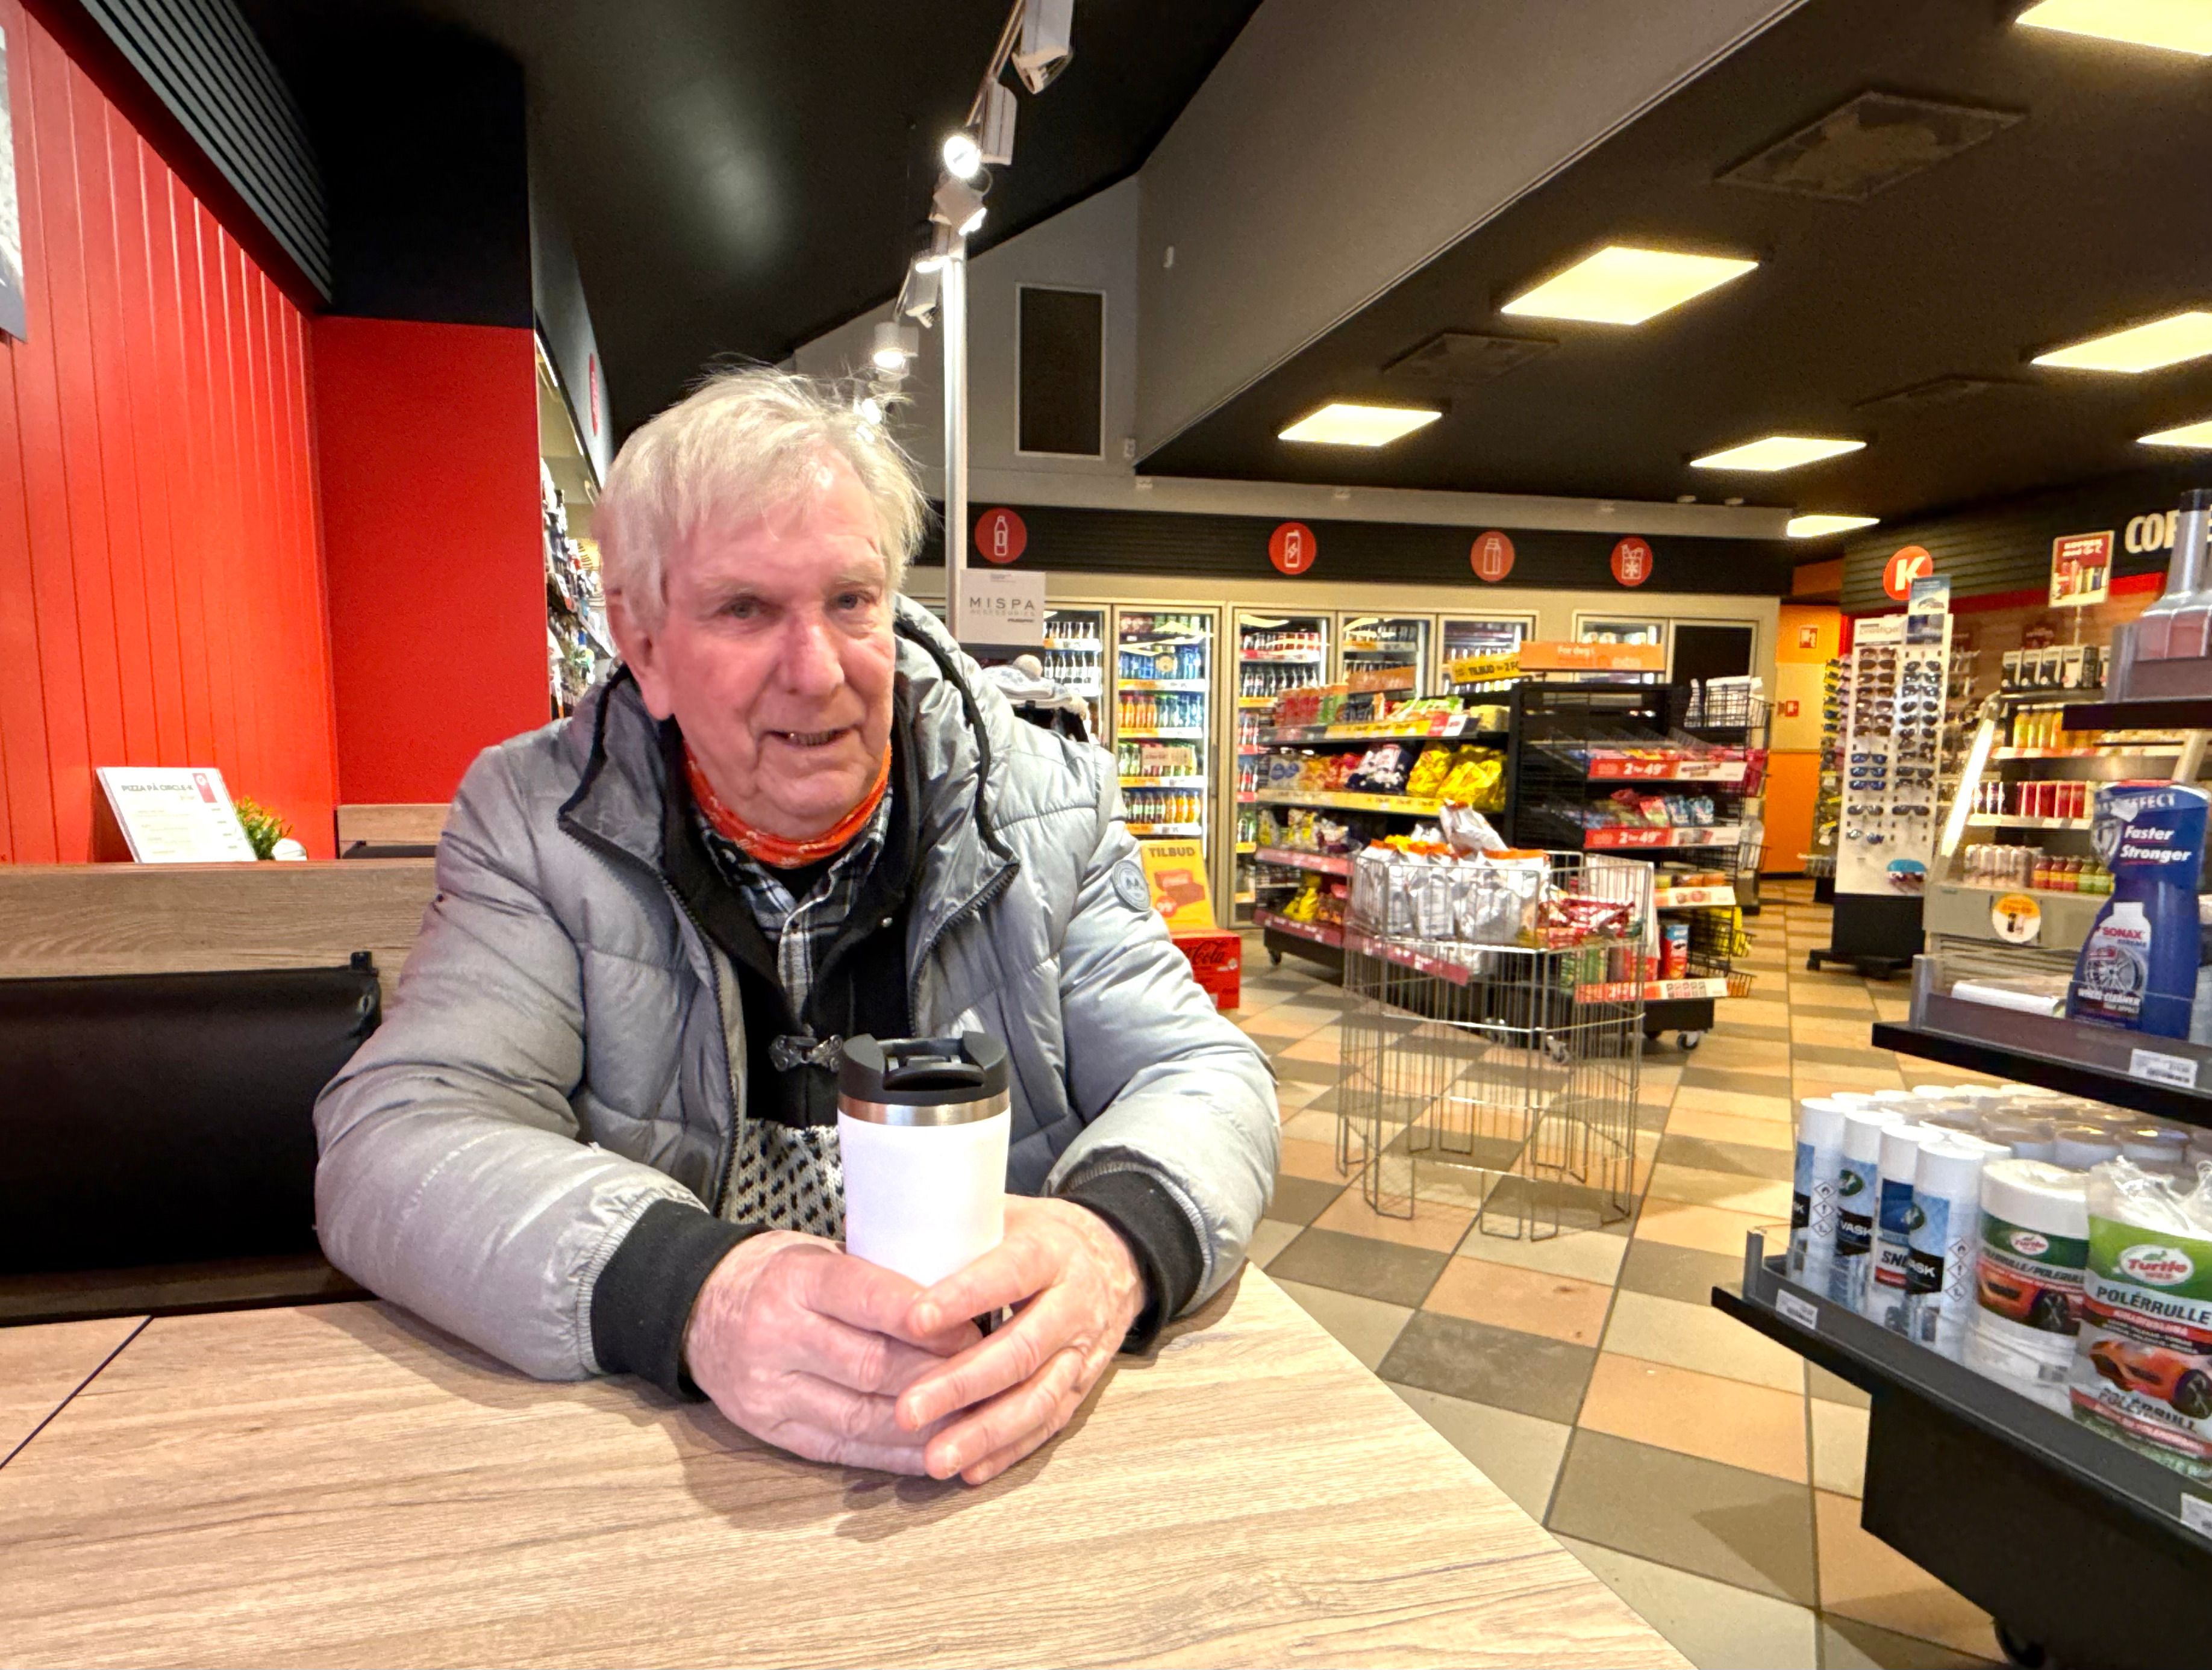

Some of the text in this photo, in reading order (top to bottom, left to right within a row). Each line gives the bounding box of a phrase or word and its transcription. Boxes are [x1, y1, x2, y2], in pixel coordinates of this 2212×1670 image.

[1895, 556, 1926, 591] K
[970, 597, 1034, 609] MISPA
[1623, 763, 1632, 775] 2
[146, 782, 160, 791] PÅ
[1619, 832, 1628, 844] 2
[2125, 825, 2175, 841] Faster
[1148, 847, 1196, 858] TILBUD
[2120, 844, 2192, 864] Stronger
[2103, 927, 2142, 939] SONAX
[2128, 1258, 2189, 1273] Turtle
[2097, 1286, 2212, 1326] POLÉRRULLE
